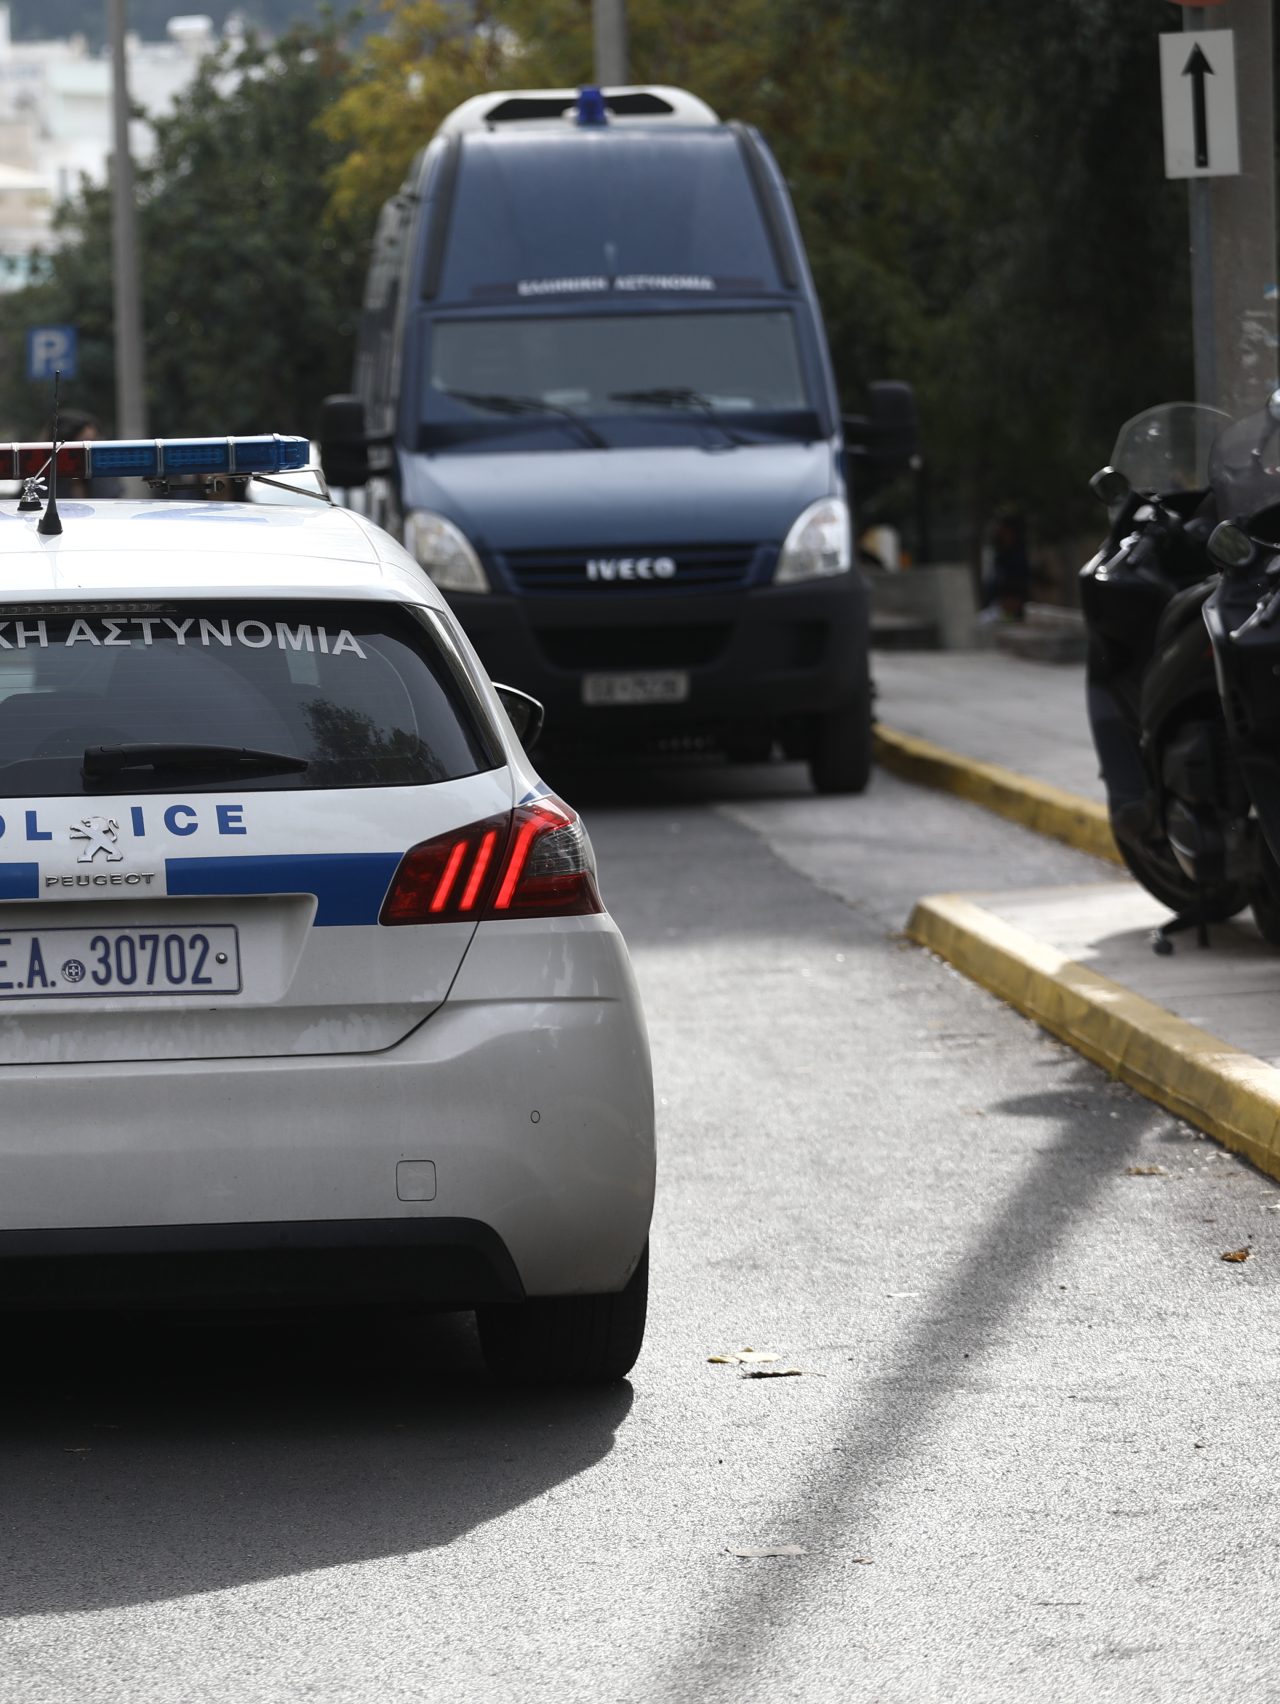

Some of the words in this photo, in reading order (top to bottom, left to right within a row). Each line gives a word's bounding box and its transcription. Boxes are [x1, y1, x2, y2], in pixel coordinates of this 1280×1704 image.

[32, 329, 68, 377] P
[586, 557, 676, 581] IVECO
[65, 618, 368, 660] ΑΣΤΥΝΟΜΙΑ
[45, 872, 156, 888] PEUGEOT
[90, 934, 212, 985] 30702
